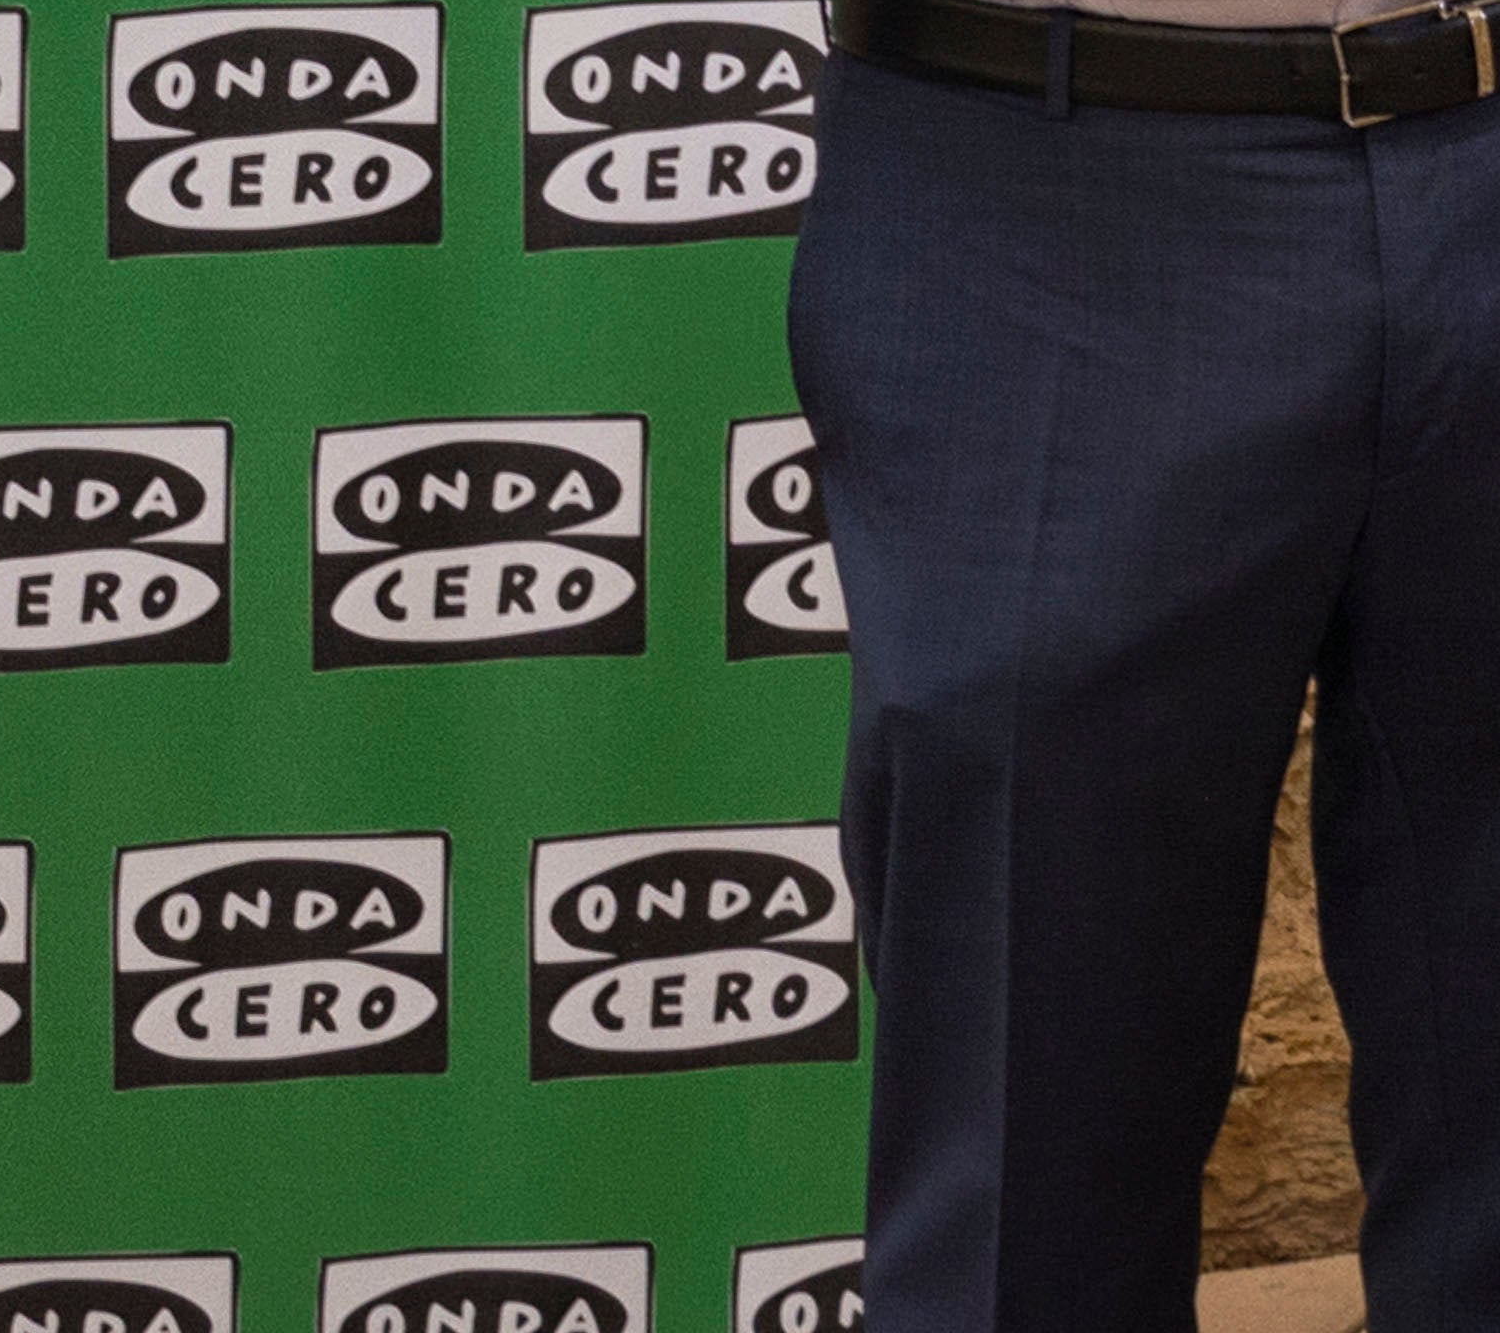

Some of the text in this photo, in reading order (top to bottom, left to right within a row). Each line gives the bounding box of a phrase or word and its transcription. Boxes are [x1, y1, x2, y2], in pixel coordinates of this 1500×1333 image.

[155, 58, 390, 109] ONDA
[572, 50, 802, 103] ONDA
[171, 153, 389, 208] CERO
[587, 146, 801, 202] CERO
[360, 470, 593, 523] ONDA
[375, 565, 593, 621] CERO
[162, 888, 395, 940] ONDA
[578, 877, 807, 932] ONDA
[177, 983, 395, 1040] CERO
[592, 972, 808, 1031] CERO
